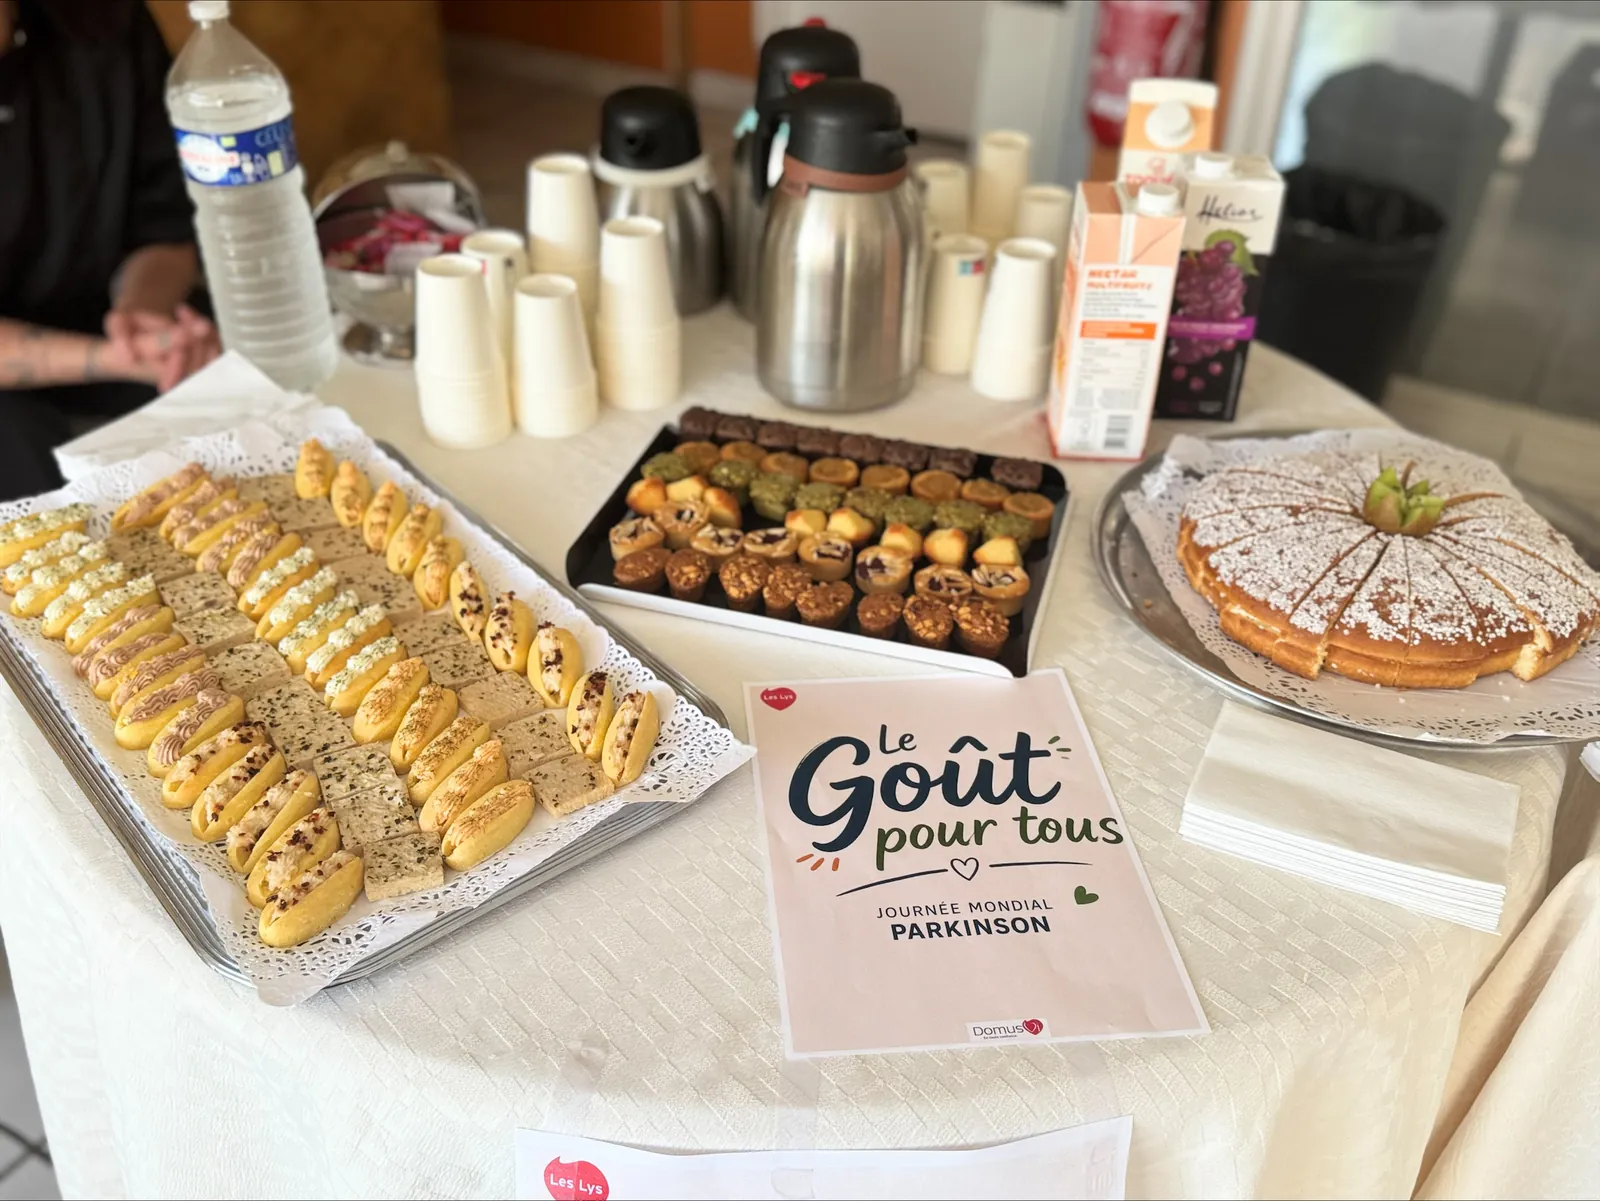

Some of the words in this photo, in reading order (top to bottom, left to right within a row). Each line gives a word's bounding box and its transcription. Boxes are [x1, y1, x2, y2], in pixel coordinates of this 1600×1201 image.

[879, 724, 918, 753] Le
[788, 731, 1062, 853] Goût
[876, 819, 997, 870] pour
[1013, 806, 1123, 845] tous
[876, 900, 962, 919] JOURNÉE
[969, 898, 1053, 913] MONDIAL
[890, 916, 1052, 941] PARKINSON
[549, 1173, 574, 1189] Les
[579, 1179, 603, 1195] Lys
